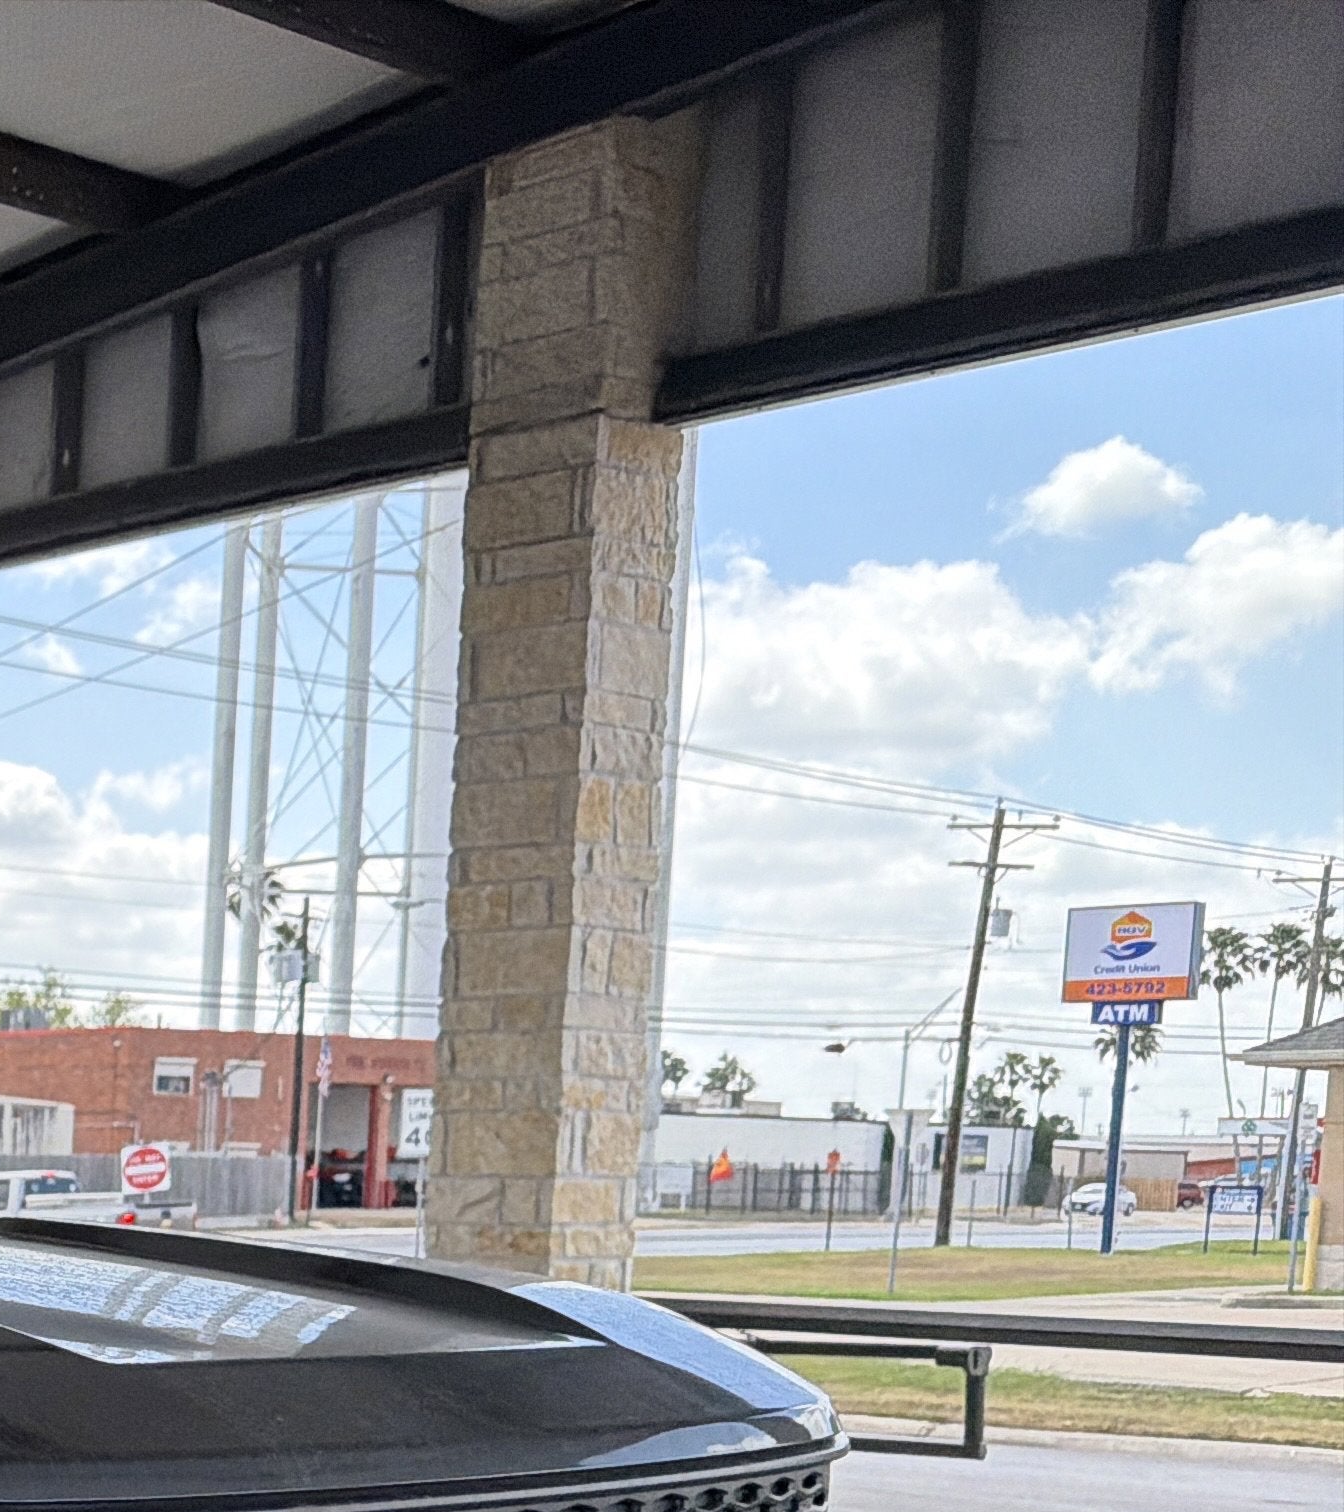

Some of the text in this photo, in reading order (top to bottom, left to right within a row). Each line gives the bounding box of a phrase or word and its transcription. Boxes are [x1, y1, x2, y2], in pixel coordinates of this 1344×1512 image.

[1093, 963, 1161, 975] Credit Union
[1087, 982, 1166, 996] 423-5792
[1097, 1003, 1150, 1023] ATM
